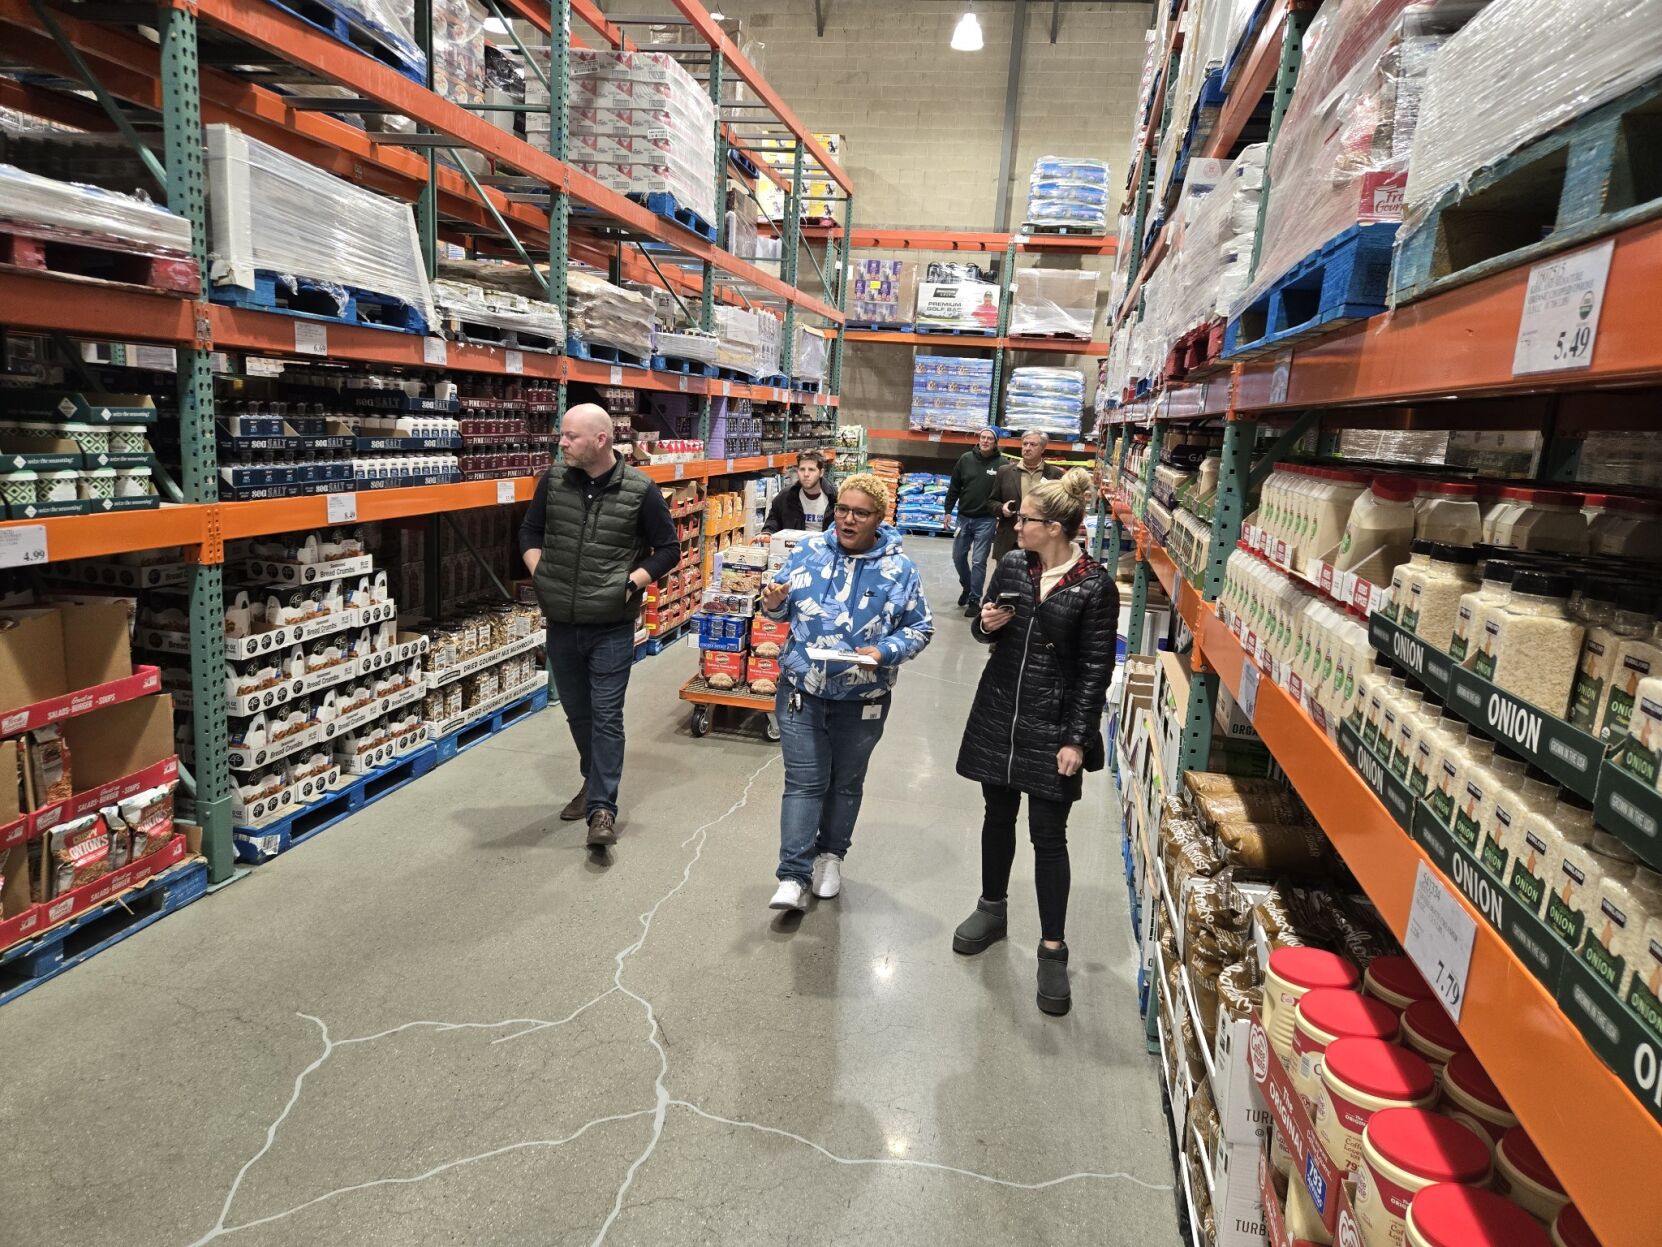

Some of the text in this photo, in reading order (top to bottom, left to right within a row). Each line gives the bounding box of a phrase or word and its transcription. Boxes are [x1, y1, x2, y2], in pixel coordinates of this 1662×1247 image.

[1386, 190, 1404, 203] Fre
[1554, 326, 1590, 360] 5.49
[267, 439, 286, 448] SALT
[328, 438, 343, 447] SALT
[385, 439, 401, 448] SALT
[436, 438, 451, 447] SALT
[252, 487, 287, 498] sea SALT
[328, 482, 345, 491] SALT
[24, 550, 45, 561] 4.99
[320, 567, 355, 578] Bread Crumbs
[322, 623, 337, 633] Crumbs
[464, 662, 477, 672] DRIED
[480, 652, 500, 666] GOURMET
[511, 638, 534, 653] MUSHROOMS
[1394, 632, 1424, 673] ONION
[1476, 663, 1491, 678] ONION
[307, 674, 340, 689] Bread Crumbs
[1577, 682, 1596, 700] ONION
[1611, 701, 1633, 717] ONIO
[338, 714, 366, 732] Bread Crumbs
[1232, 724, 1258, 736] ORGA
[1488, 693, 1542, 754] ONION
[270, 740, 304, 759] Bread Crumbs
[1358, 746, 1384, 795] ONION
[1626, 752, 1654, 778] ONION
[1436, 797, 1449, 816] ONION
[73, 828, 98, 844] CRISPY
[1457, 822, 1474, 842] ONION
[69, 834, 109, 860] ONIONS
[1527, 832, 1546, 852] KIRKLAND
[1485, 847, 1501, 870] ONION
[1564, 860, 1585, 881] KIRKLAND
[1453, 852, 1503, 931] ONION
[1515, 874, 1539, 902] ONION
[1602, 899, 1626, 922] KIRKLAND
[1550, 906, 1575, 936] ONION
[1586, 948, 1616, 983] ONION
[1436, 960, 1460, 1005] 7.79
[1283, 1086, 1294, 1114] The
[1246, 1109, 1273, 1125] TUR
[1270, 1083, 1303, 1160] ORIGINAL
[1345, 1115, 1366, 1126] ORIGIN
[1344, 1144, 1360, 1156] Love
[1345, 1160, 1359, 1171] 79
[1308, 1162, 1322, 1194] 793
[1391, 1198, 1407, 1209] ORIG
[1236, 1219, 1268, 1236] TURB
[1391, 1224, 1404, 1234] Cof
